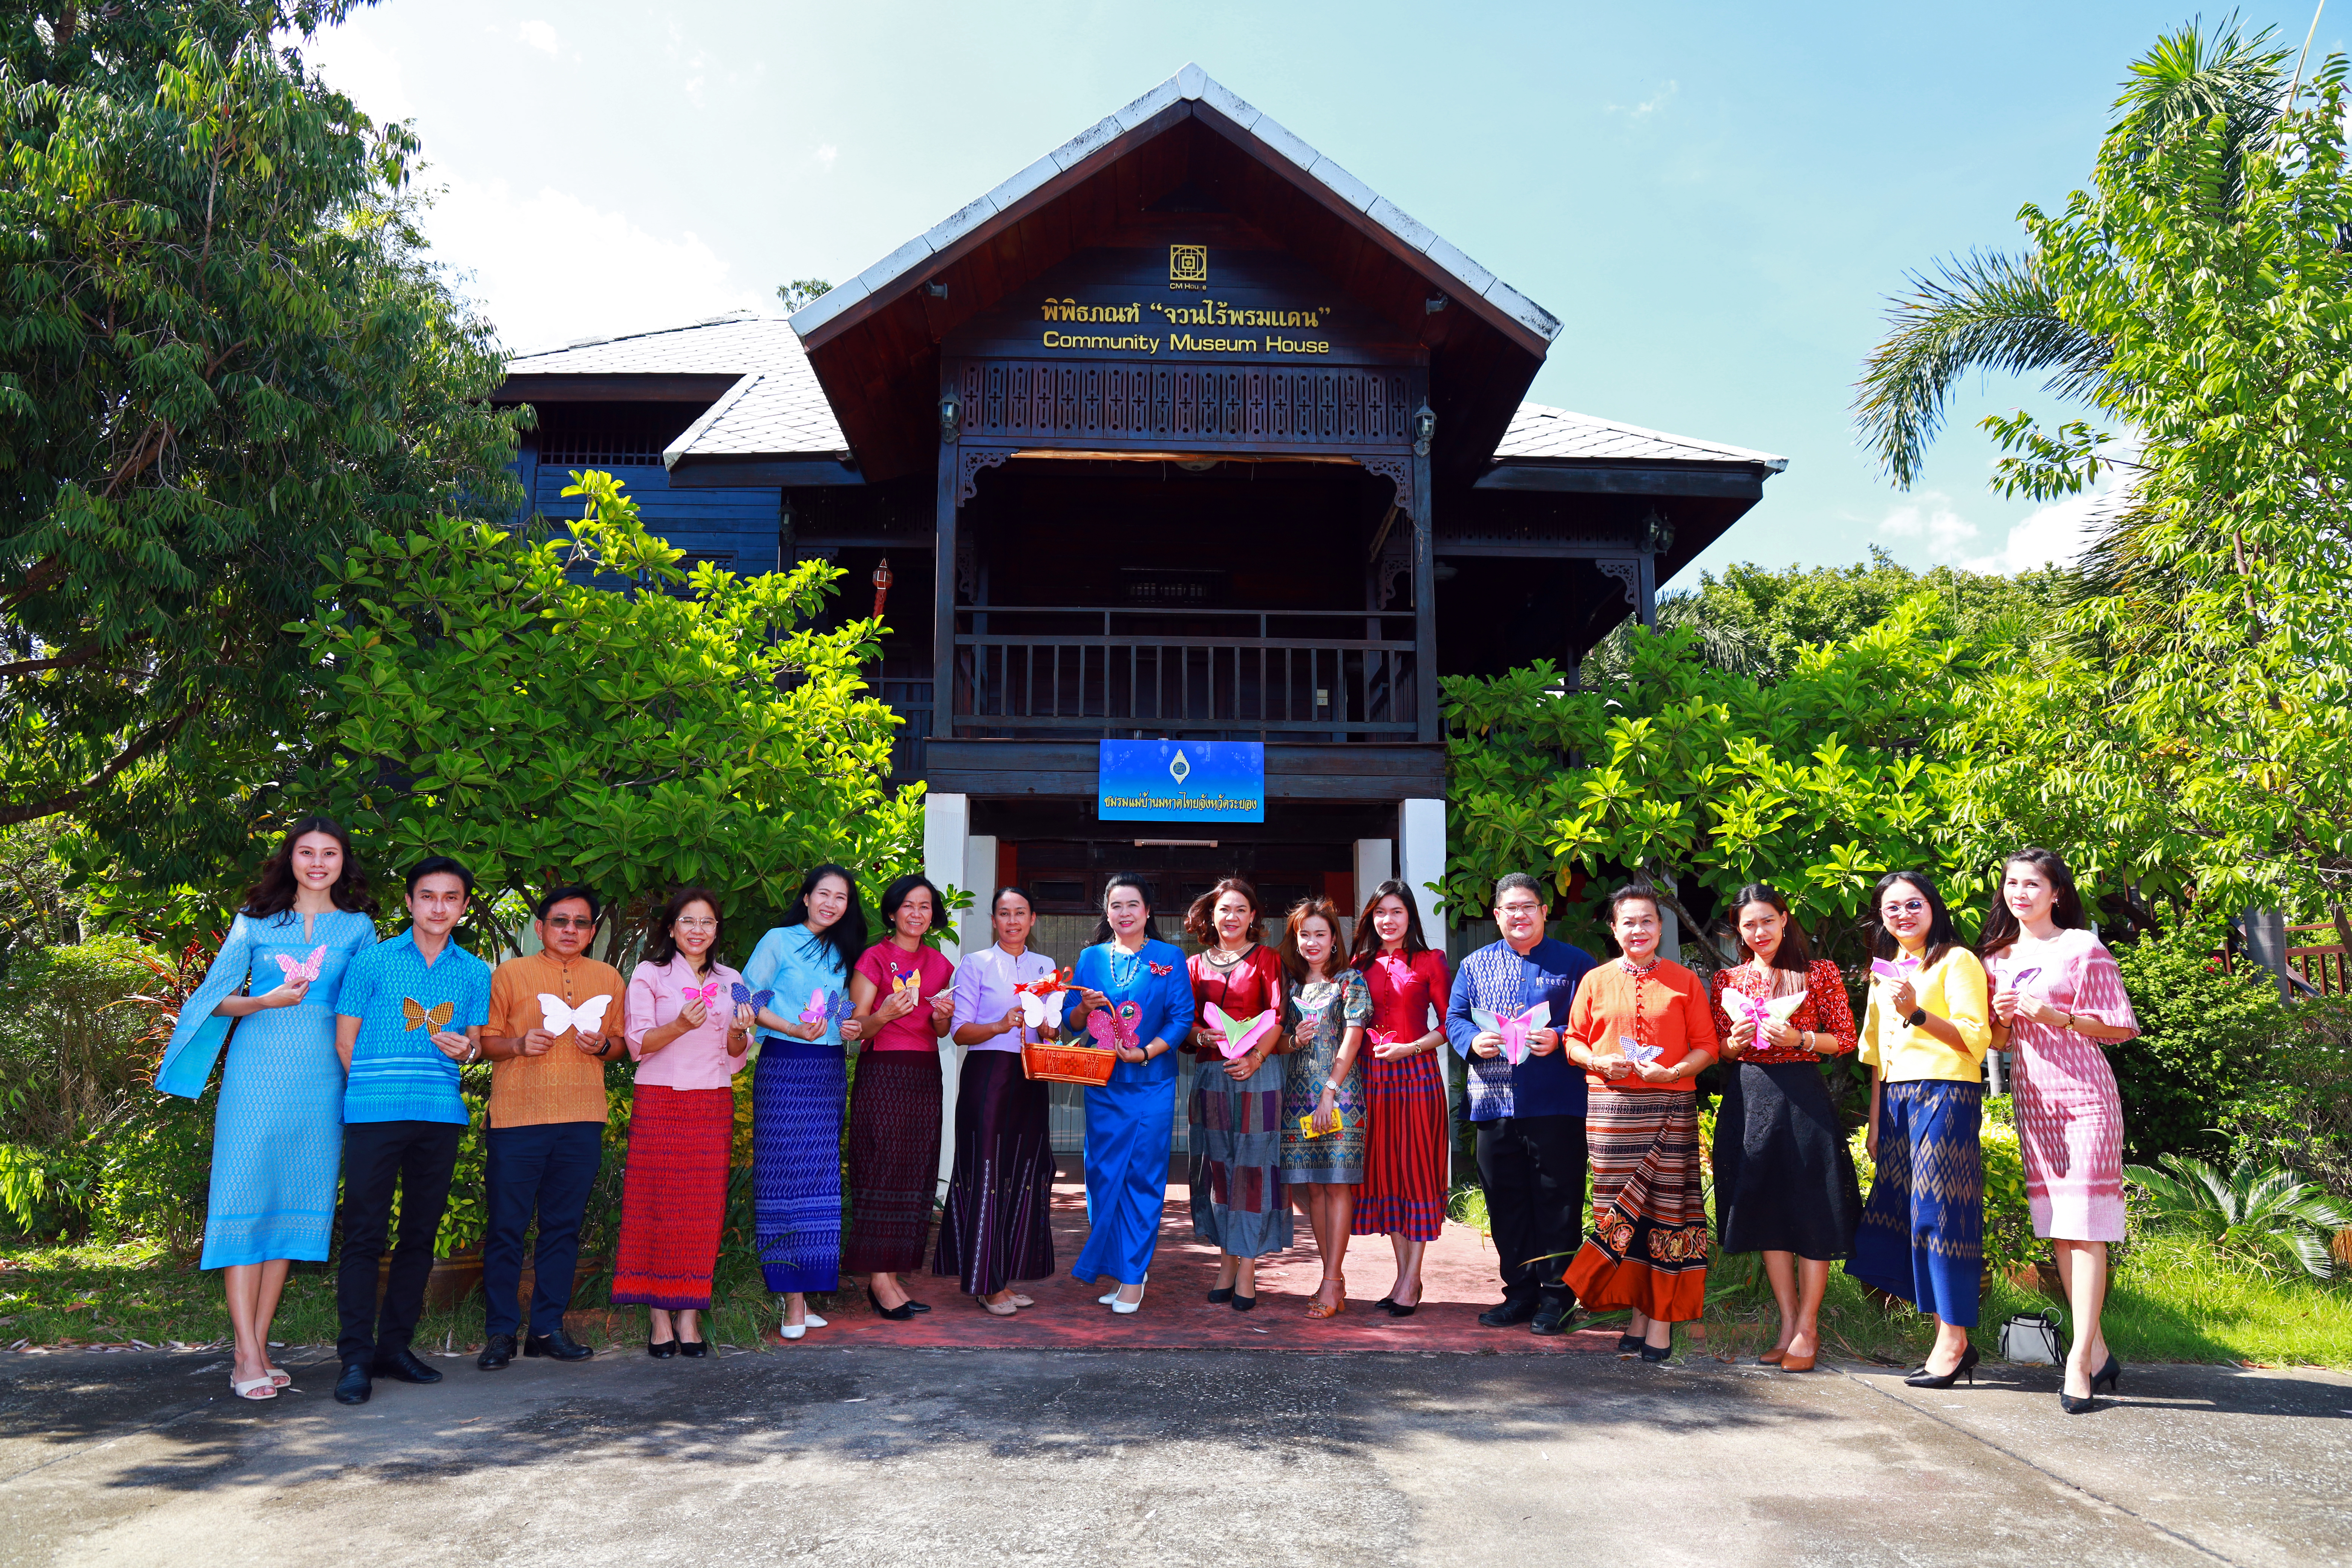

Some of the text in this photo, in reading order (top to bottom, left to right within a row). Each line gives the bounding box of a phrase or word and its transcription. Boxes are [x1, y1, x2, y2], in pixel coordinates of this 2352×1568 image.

[1043, 331, 1329, 354] Community Museum House
[1104, 790, 1257, 811] ชมรมแม่บ้านมหาดไทยจังหวัดระยอง
